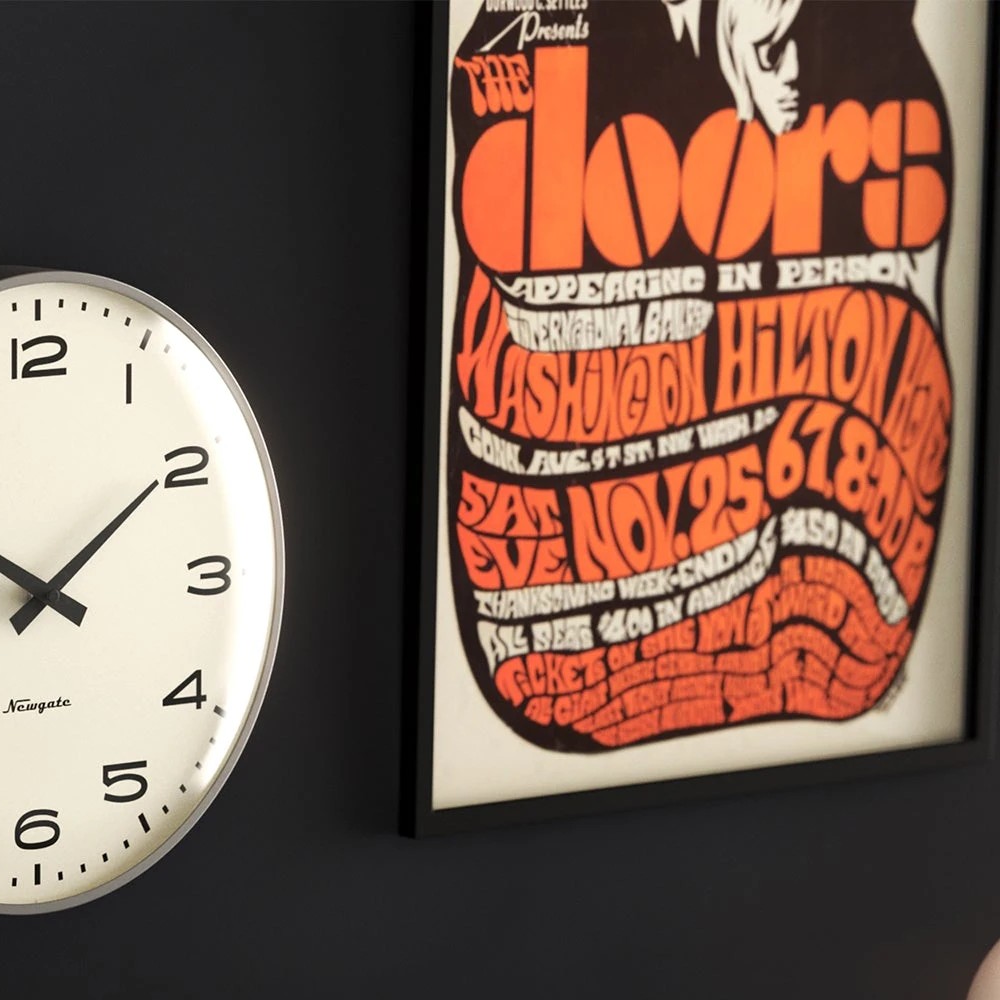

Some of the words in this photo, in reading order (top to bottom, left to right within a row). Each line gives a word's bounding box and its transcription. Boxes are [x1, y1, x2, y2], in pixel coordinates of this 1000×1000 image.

[479, 11, 589, 52] Presents
[455, 53, 534, 117] THE
[462, 45, 947, 272] doors
[777, 251, 938, 325] PERSON
[11, 334, 68, 380] 12
[126, 363, 133, 405] 1
[163, 445, 210, 489] 2
[187, 555, 232, 596] 3
[2, 696, 72, 714] Newgate
[162, 669, 208, 710] 4
[102, 760, 148, 803] 5
[13, 809, 61, 850] 6
